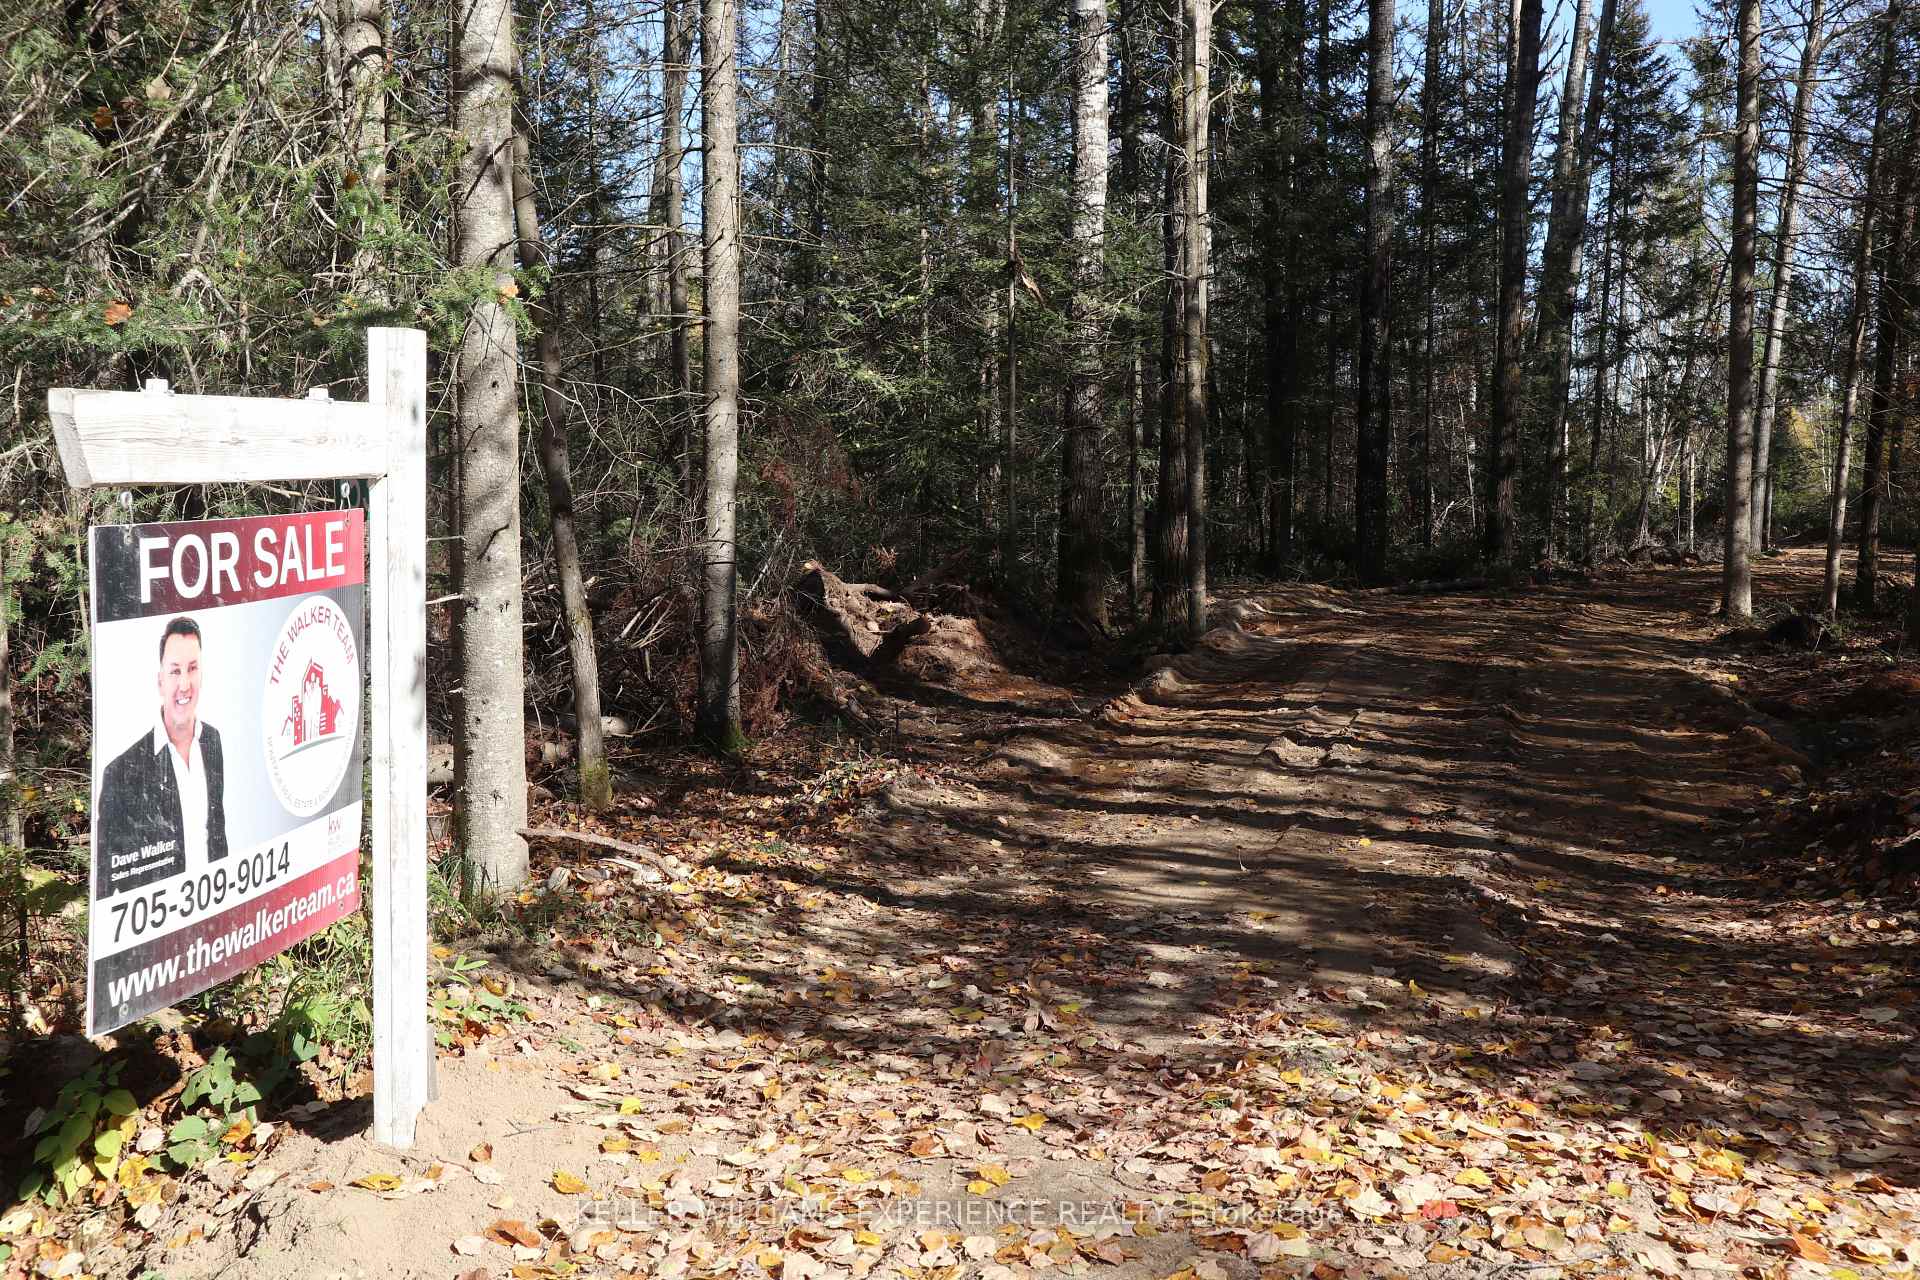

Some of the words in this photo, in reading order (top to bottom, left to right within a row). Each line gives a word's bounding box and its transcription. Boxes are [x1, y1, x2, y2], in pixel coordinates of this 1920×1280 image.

[139, 532, 242, 603] FOR
[254, 520, 345, 588] SALE
[270, 641, 289, 684] THE
[288, 606, 331, 643] WALKER
[334, 614, 354, 664] TEAM
[111, 851, 139, 869] Dave
[141, 840, 176, 859] Walker
[111, 870, 130, 881] Sales
[130, 856, 175, 875] Representative
[111, 842, 290, 943] 705-309-9014
[108, 871, 355, 1007] www.thewalkerteam.ca
